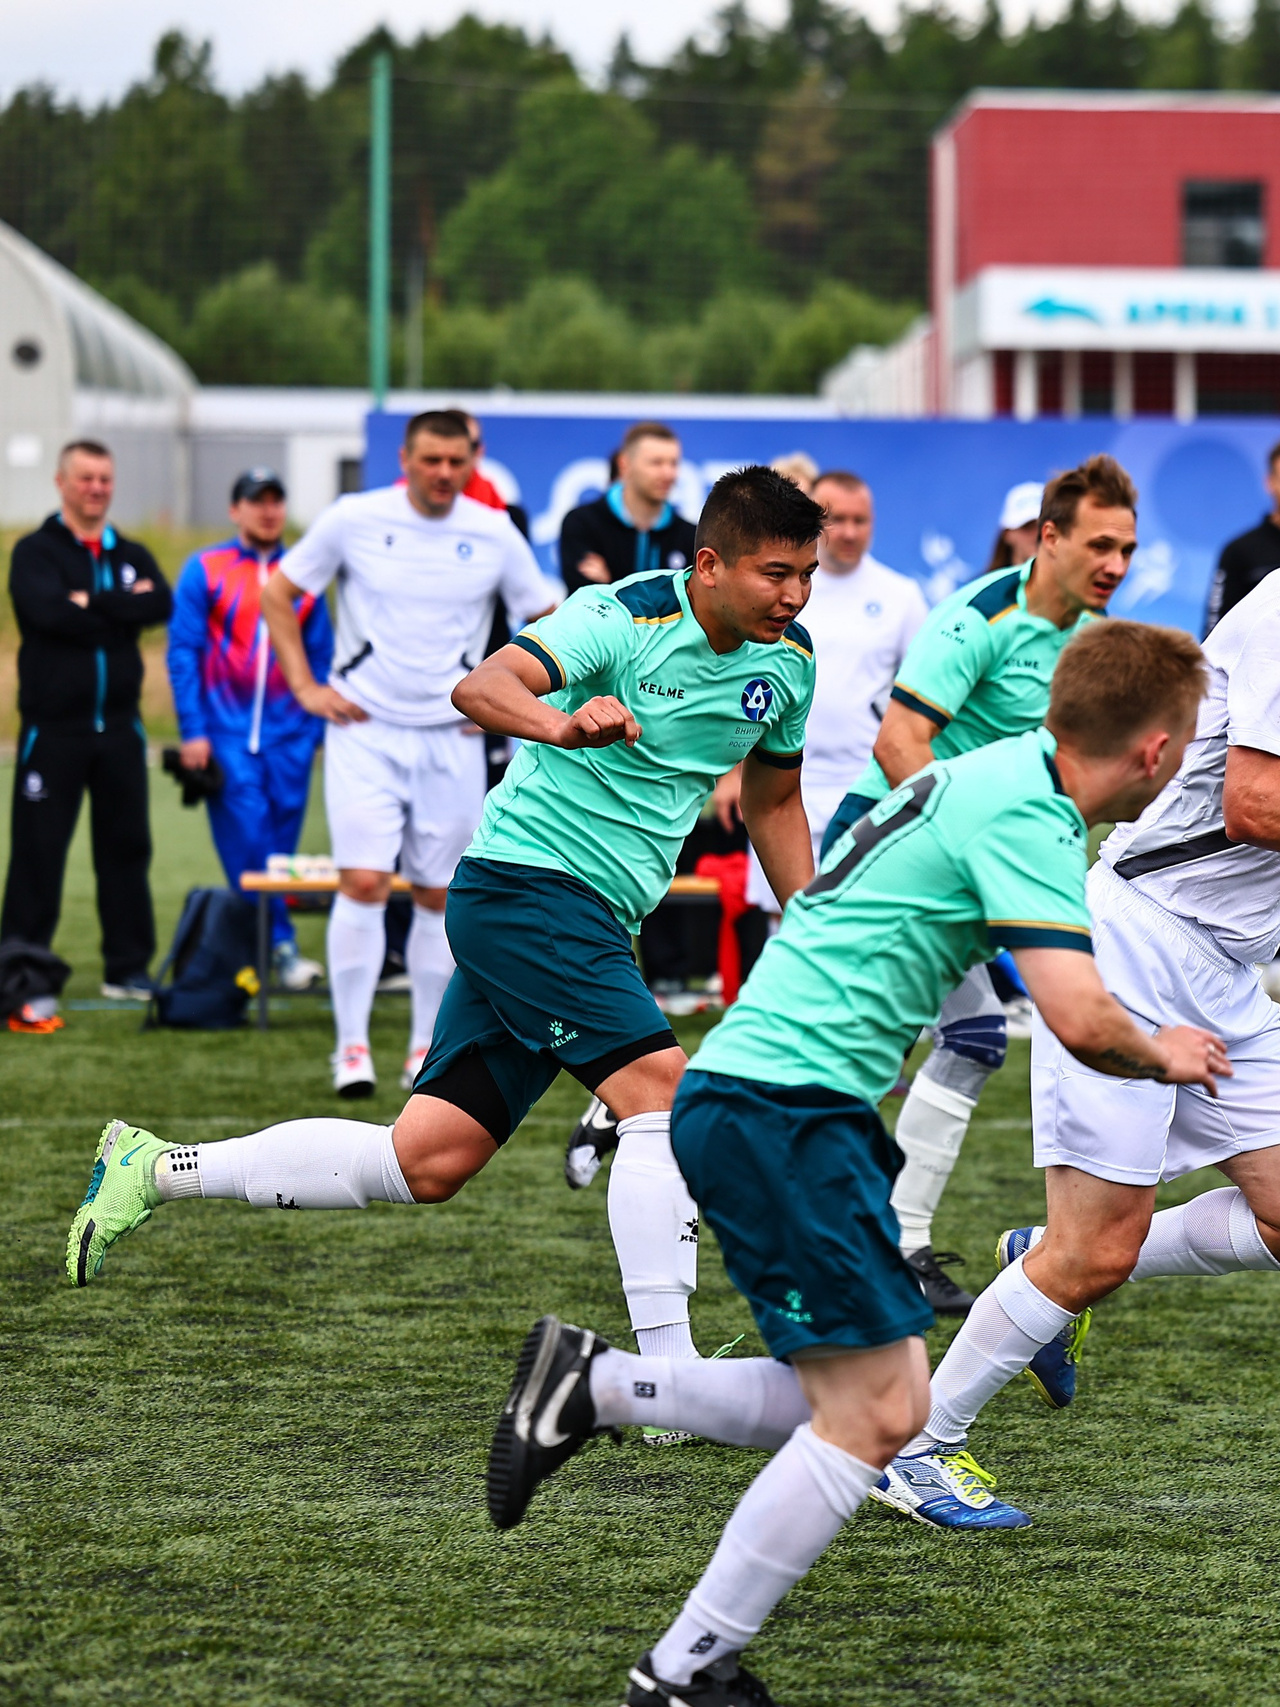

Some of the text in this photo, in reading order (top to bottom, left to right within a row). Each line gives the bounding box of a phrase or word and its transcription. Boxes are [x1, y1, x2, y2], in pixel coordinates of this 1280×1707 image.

[639, 681, 685, 699] KELME
[549, 1030, 579, 1050] KELME
[679, 1234, 699, 1243] KEL
